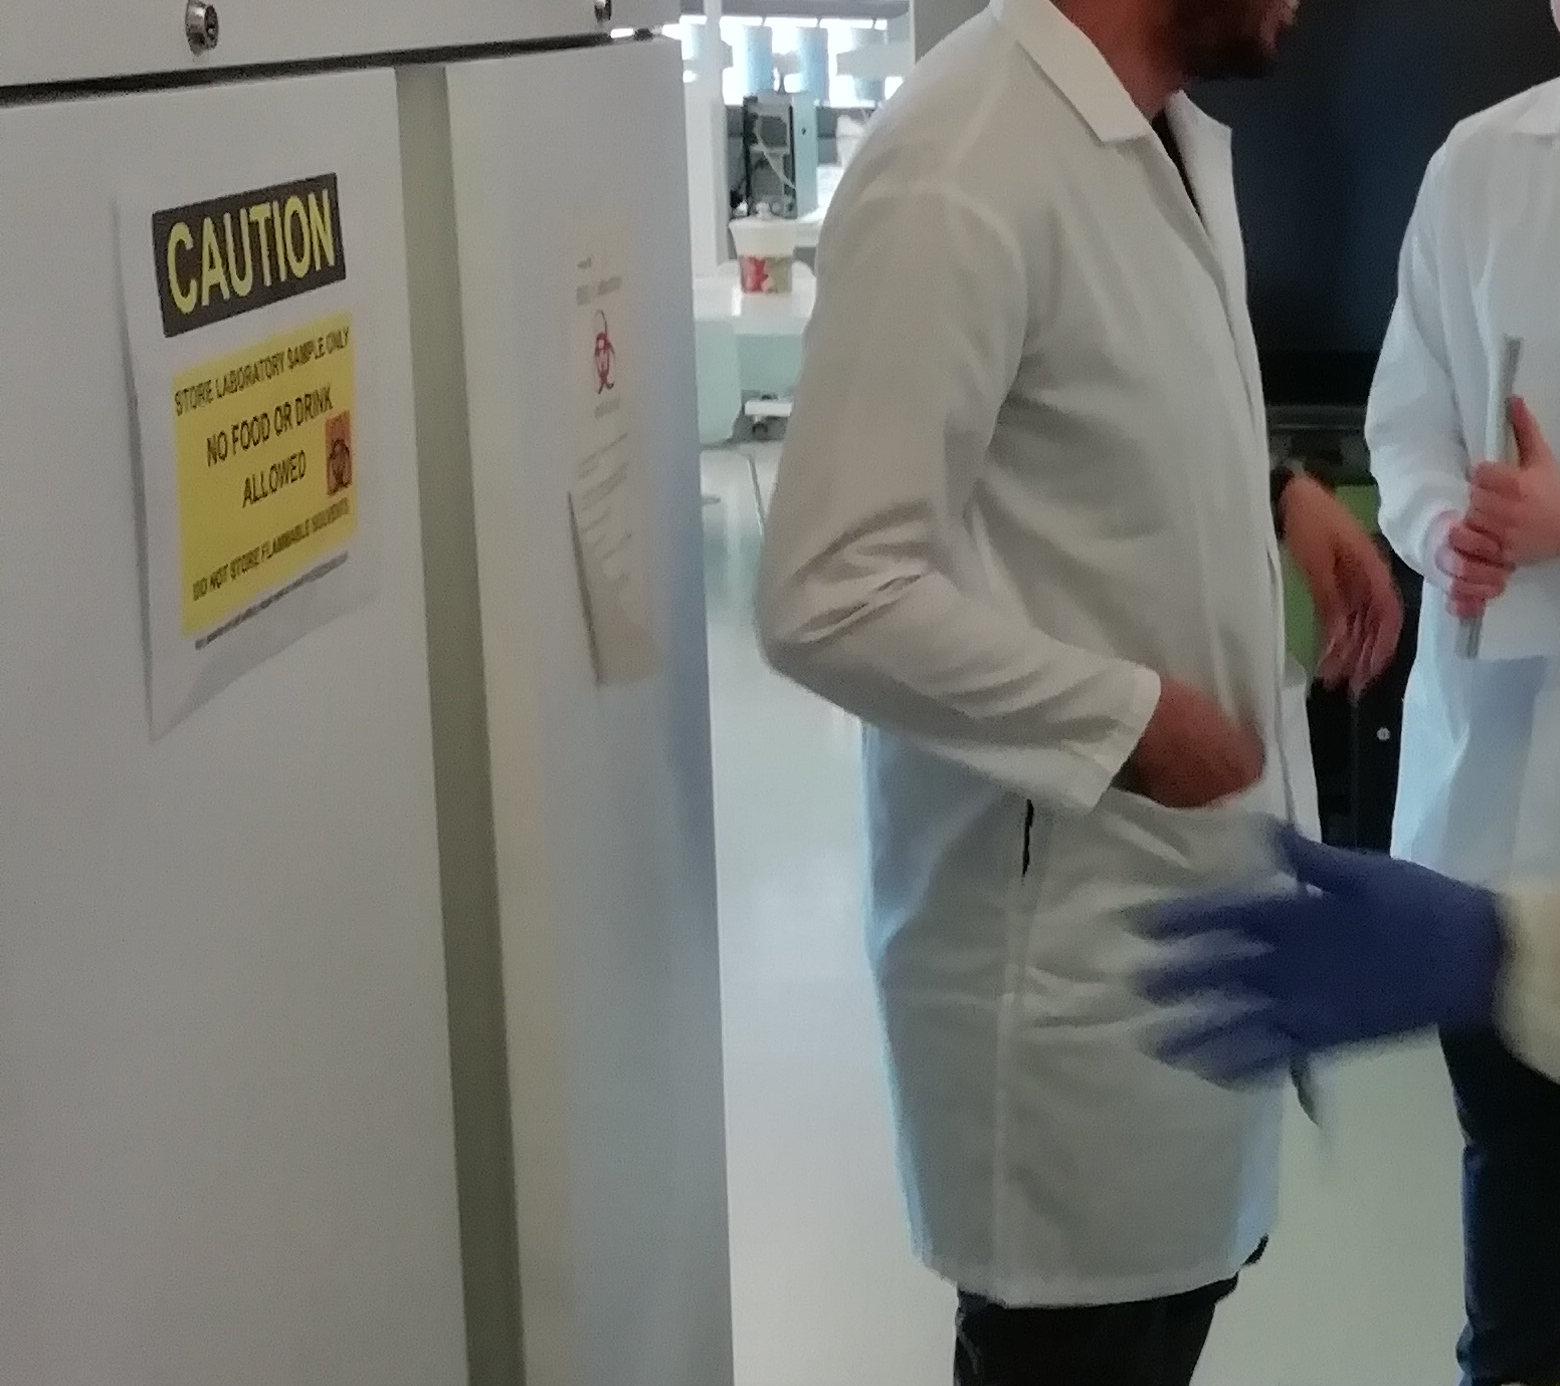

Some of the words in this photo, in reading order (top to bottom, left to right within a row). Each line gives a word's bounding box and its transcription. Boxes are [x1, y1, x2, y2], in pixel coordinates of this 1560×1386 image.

[167, 188, 335, 315] CAUTION
[175, 380, 214, 416] STORE
[216, 351, 284, 398] LABORATORY
[287, 337, 325, 370] SAMPLE
[207, 430, 228, 467] NO
[232, 412, 270, 455] FOOD
[274, 401, 293, 436] OR
[295, 386, 333, 426] DRINK
[242, 450, 306, 508] ALLOWED
